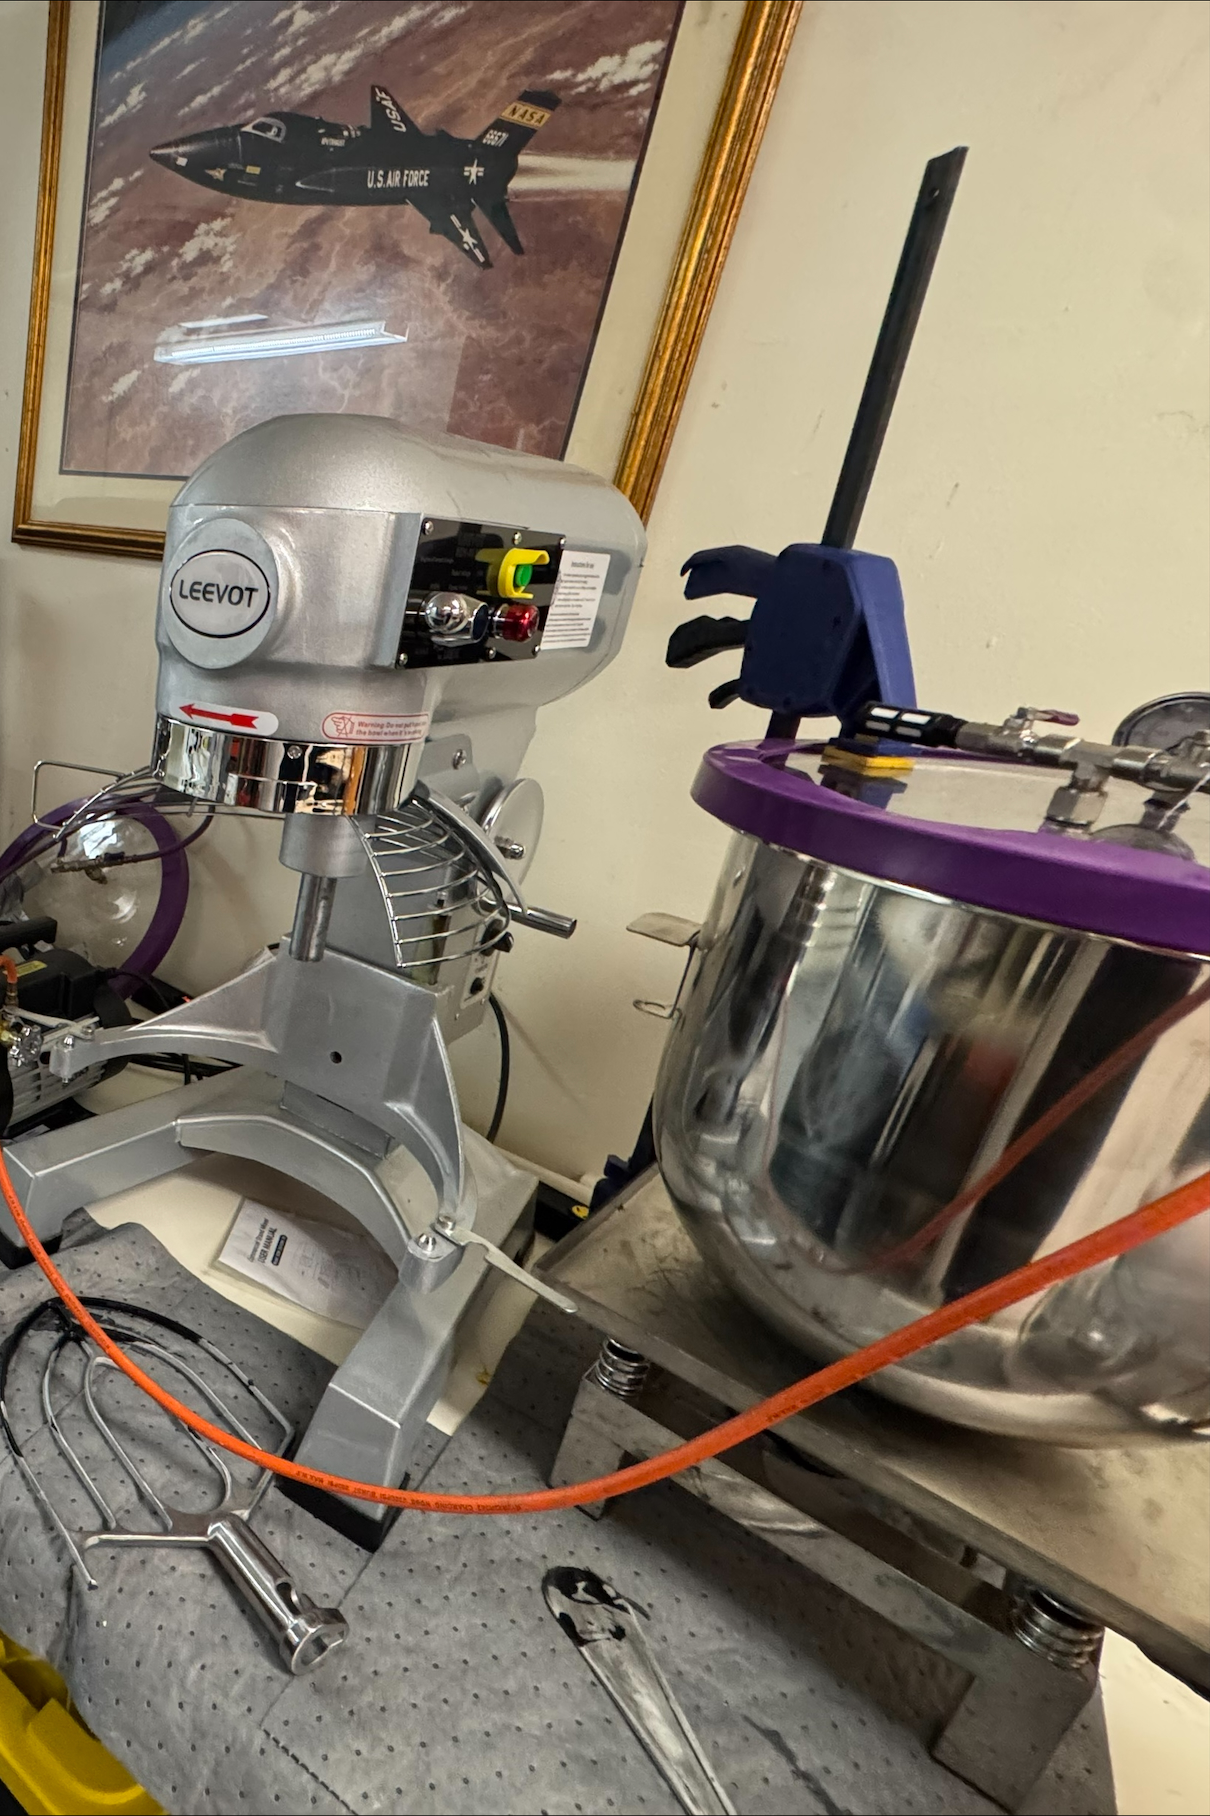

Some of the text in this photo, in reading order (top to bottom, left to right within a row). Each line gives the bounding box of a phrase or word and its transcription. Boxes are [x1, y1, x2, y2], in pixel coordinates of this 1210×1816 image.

[374, 87, 407, 132] USAF
[509, 104, 546, 125] NASA
[402, 170, 430, 187] FORCE
[179, 579, 259, 608] LEEVOT
[258, 1227, 278, 1263] USER MANUAL
